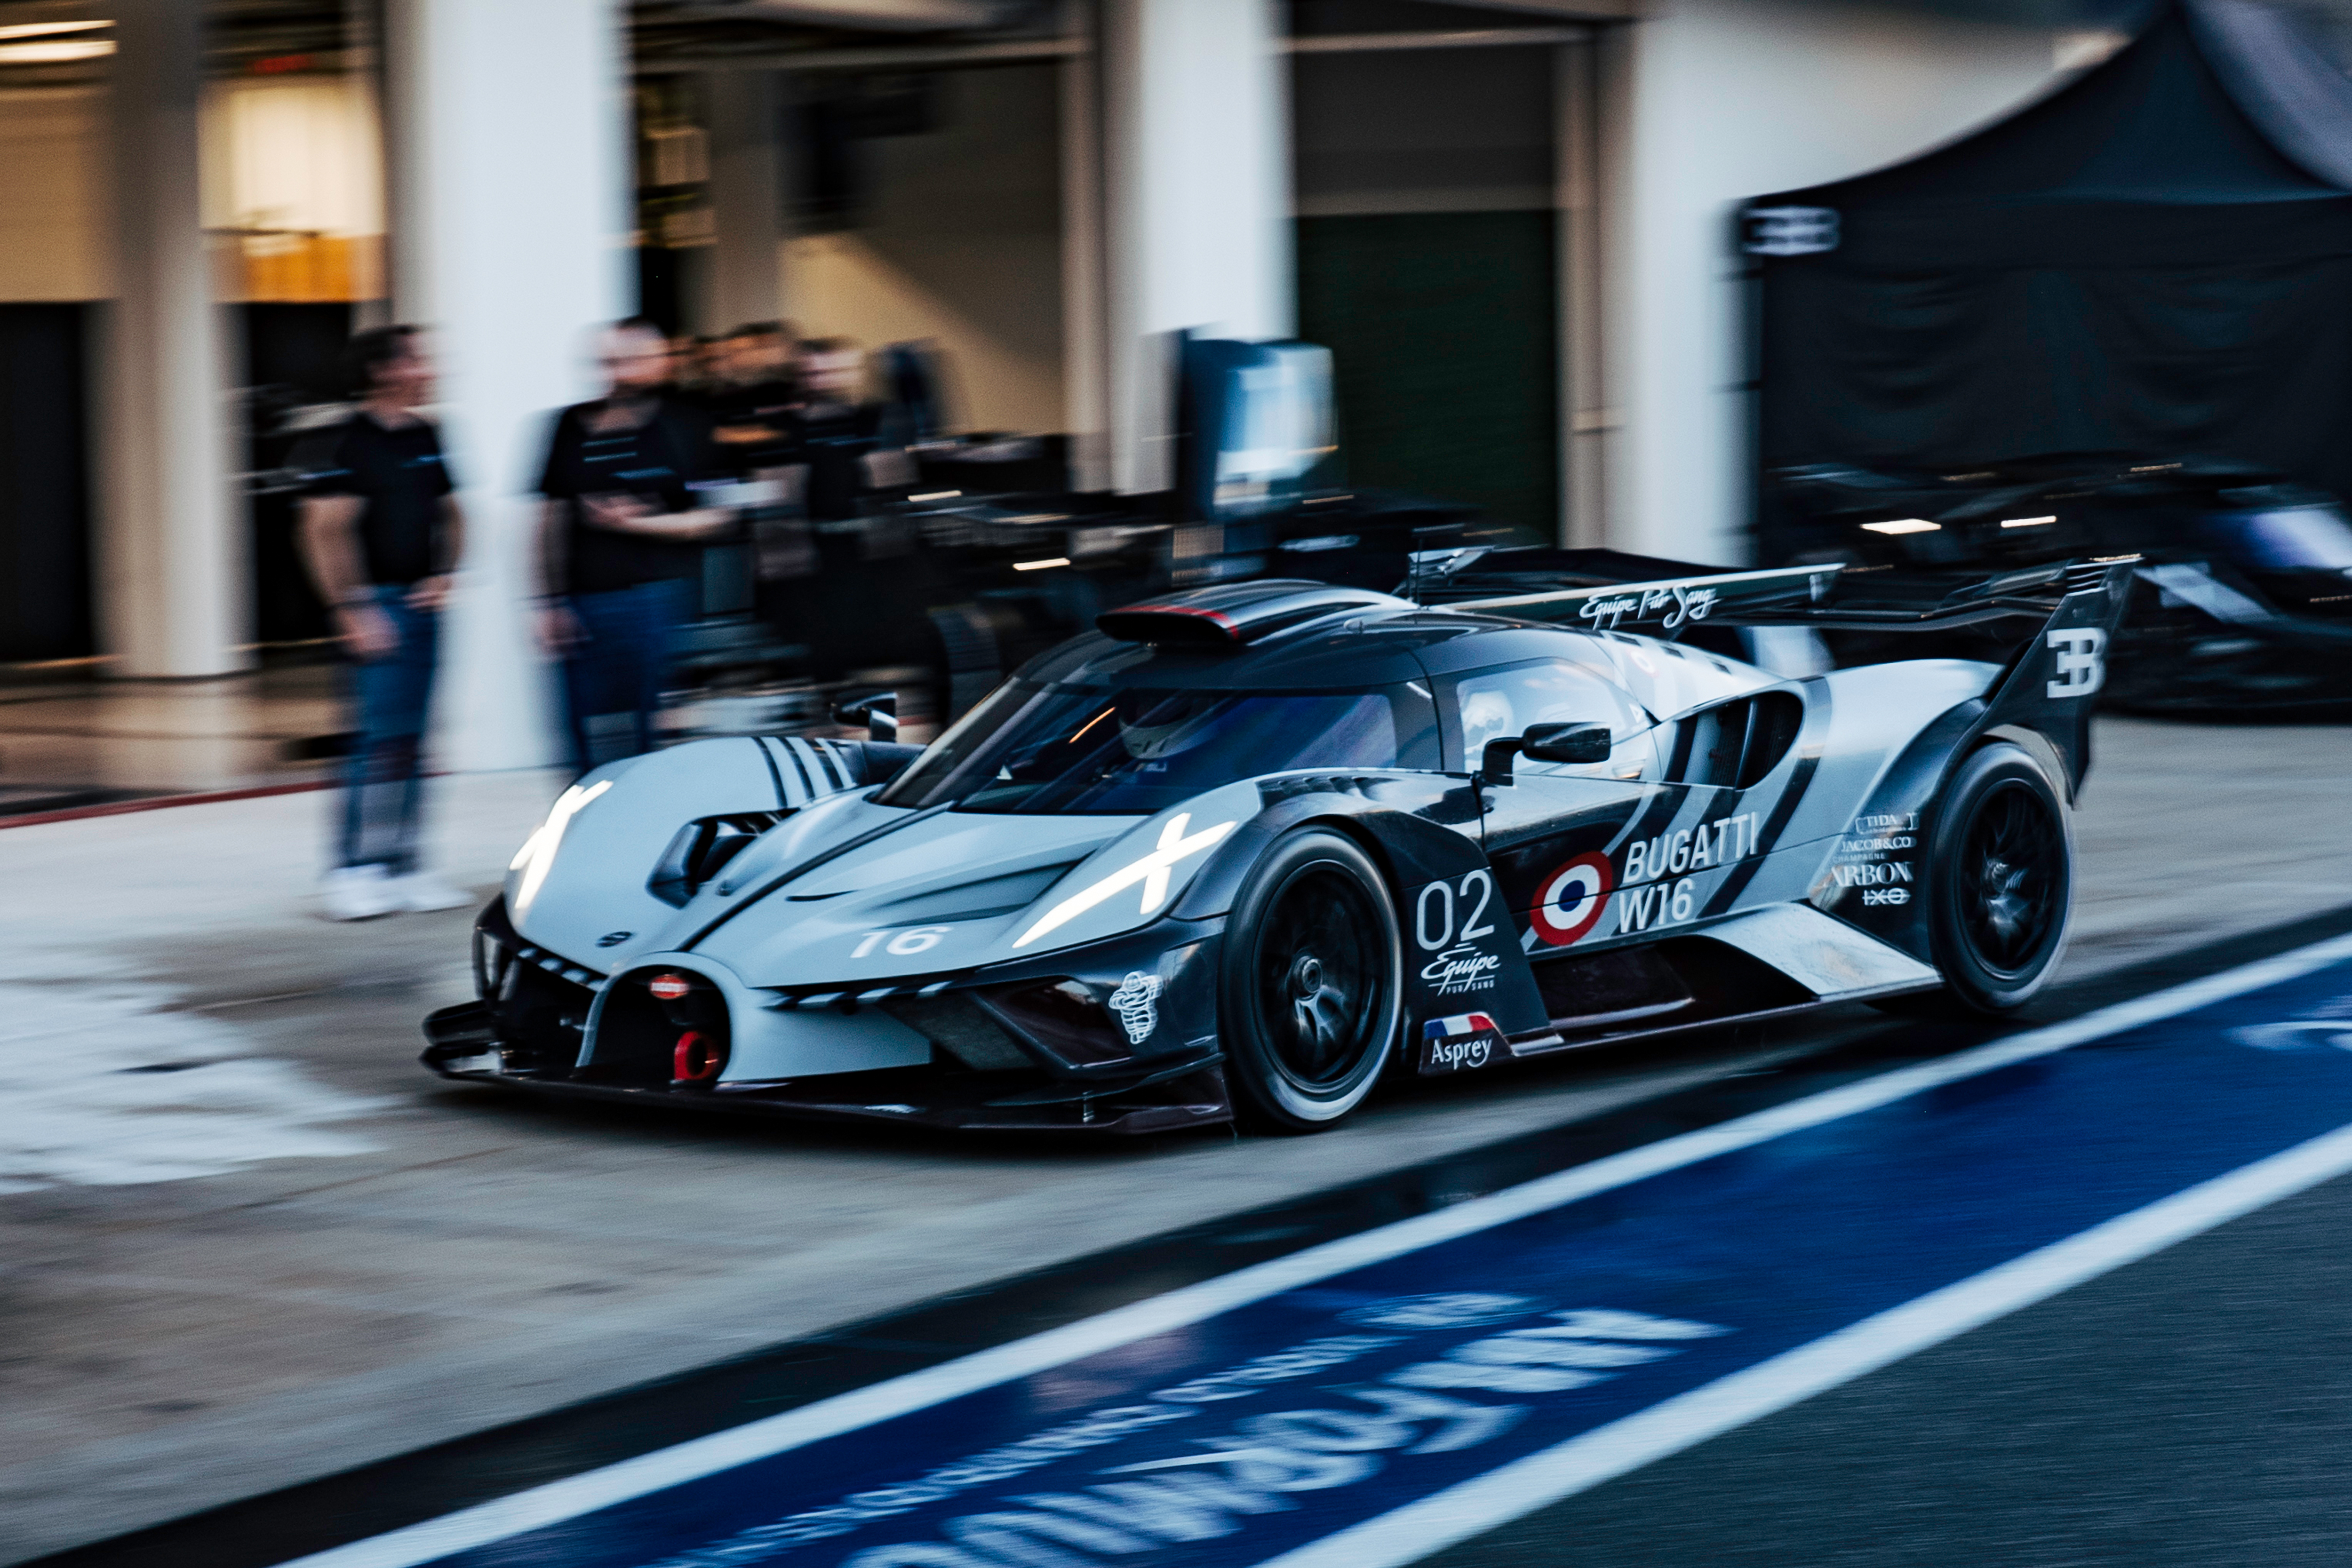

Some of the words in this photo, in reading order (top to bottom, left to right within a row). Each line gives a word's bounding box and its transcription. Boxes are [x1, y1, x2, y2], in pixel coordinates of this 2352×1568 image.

[1636, 587, 1673, 620] Pur
[1663, 581, 1721, 629] Sang
[1623, 812, 1759, 883] BUGATTI
[1417, 869, 1494, 950] 02
[1619, 878, 1695, 933] W16
[850, 926, 954, 958] 16
[1431, 1038, 1493, 1070] Asprey
